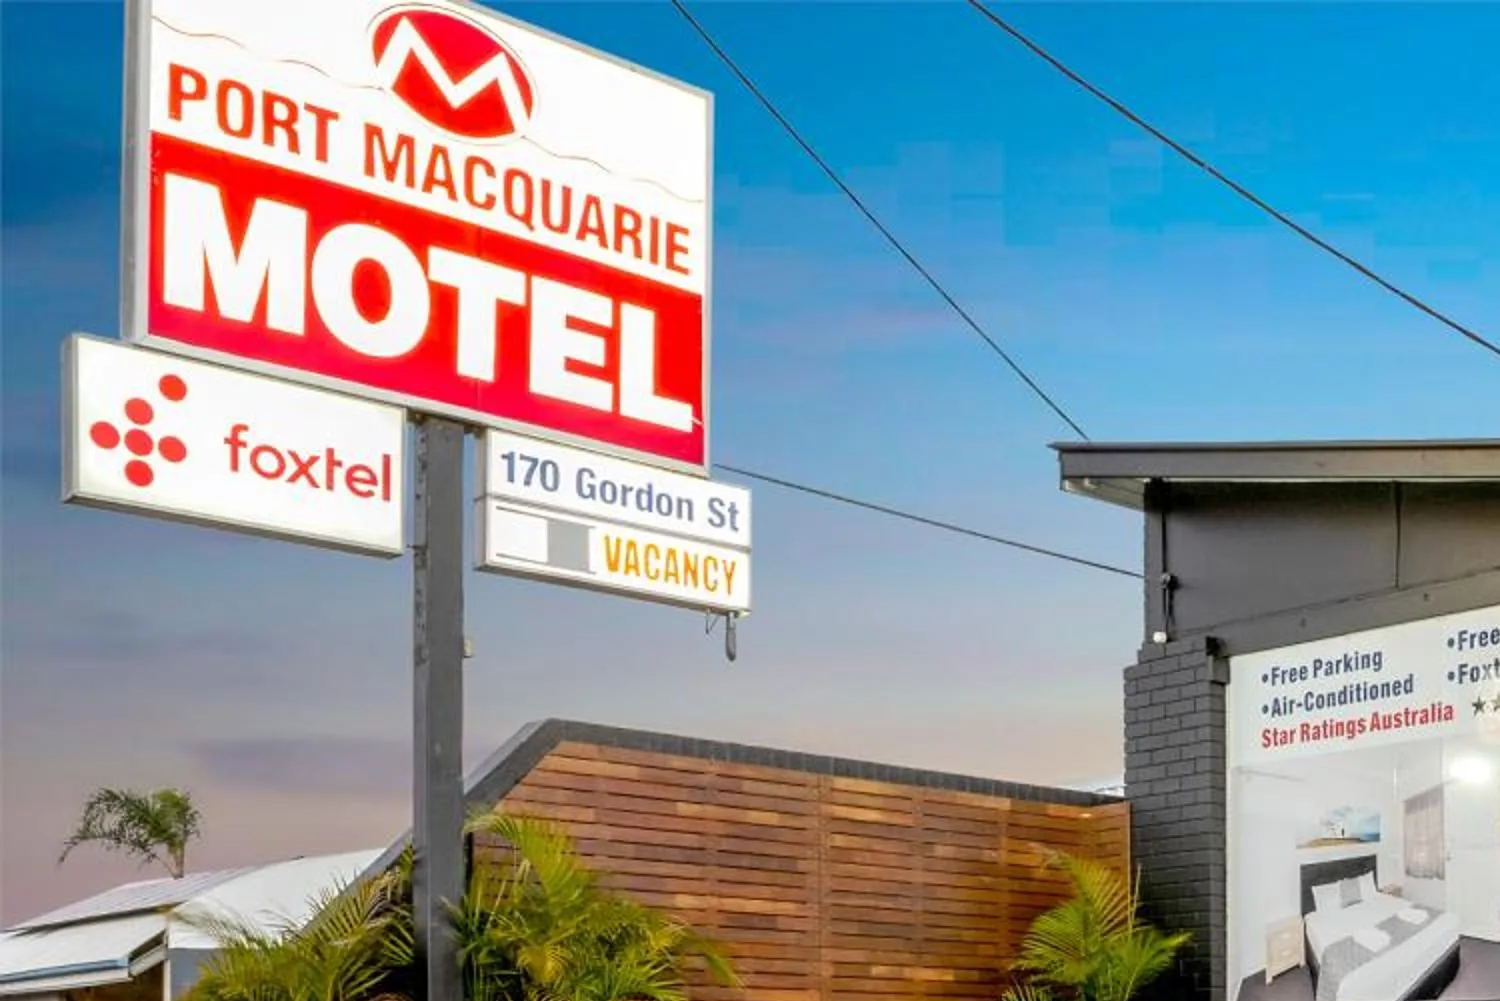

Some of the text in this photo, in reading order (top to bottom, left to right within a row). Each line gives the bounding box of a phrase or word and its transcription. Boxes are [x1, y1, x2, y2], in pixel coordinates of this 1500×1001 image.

[168, 62, 691, 276] PORT MACQUARIE
[163, 172, 694, 433] MOTEL
[223, 424, 391, 502] foxtel
[499, 450, 740, 532] 170 Gordon St
[603, 533, 737, 595] VACANCY
[1271, 650, 1383, 686] Free Parking
[1458, 627, 1500, 651] Free
[1261, 702, 1454, 749] Star Ratings Australia
[1271, 673, 1414, 719] Air-Conditioned
